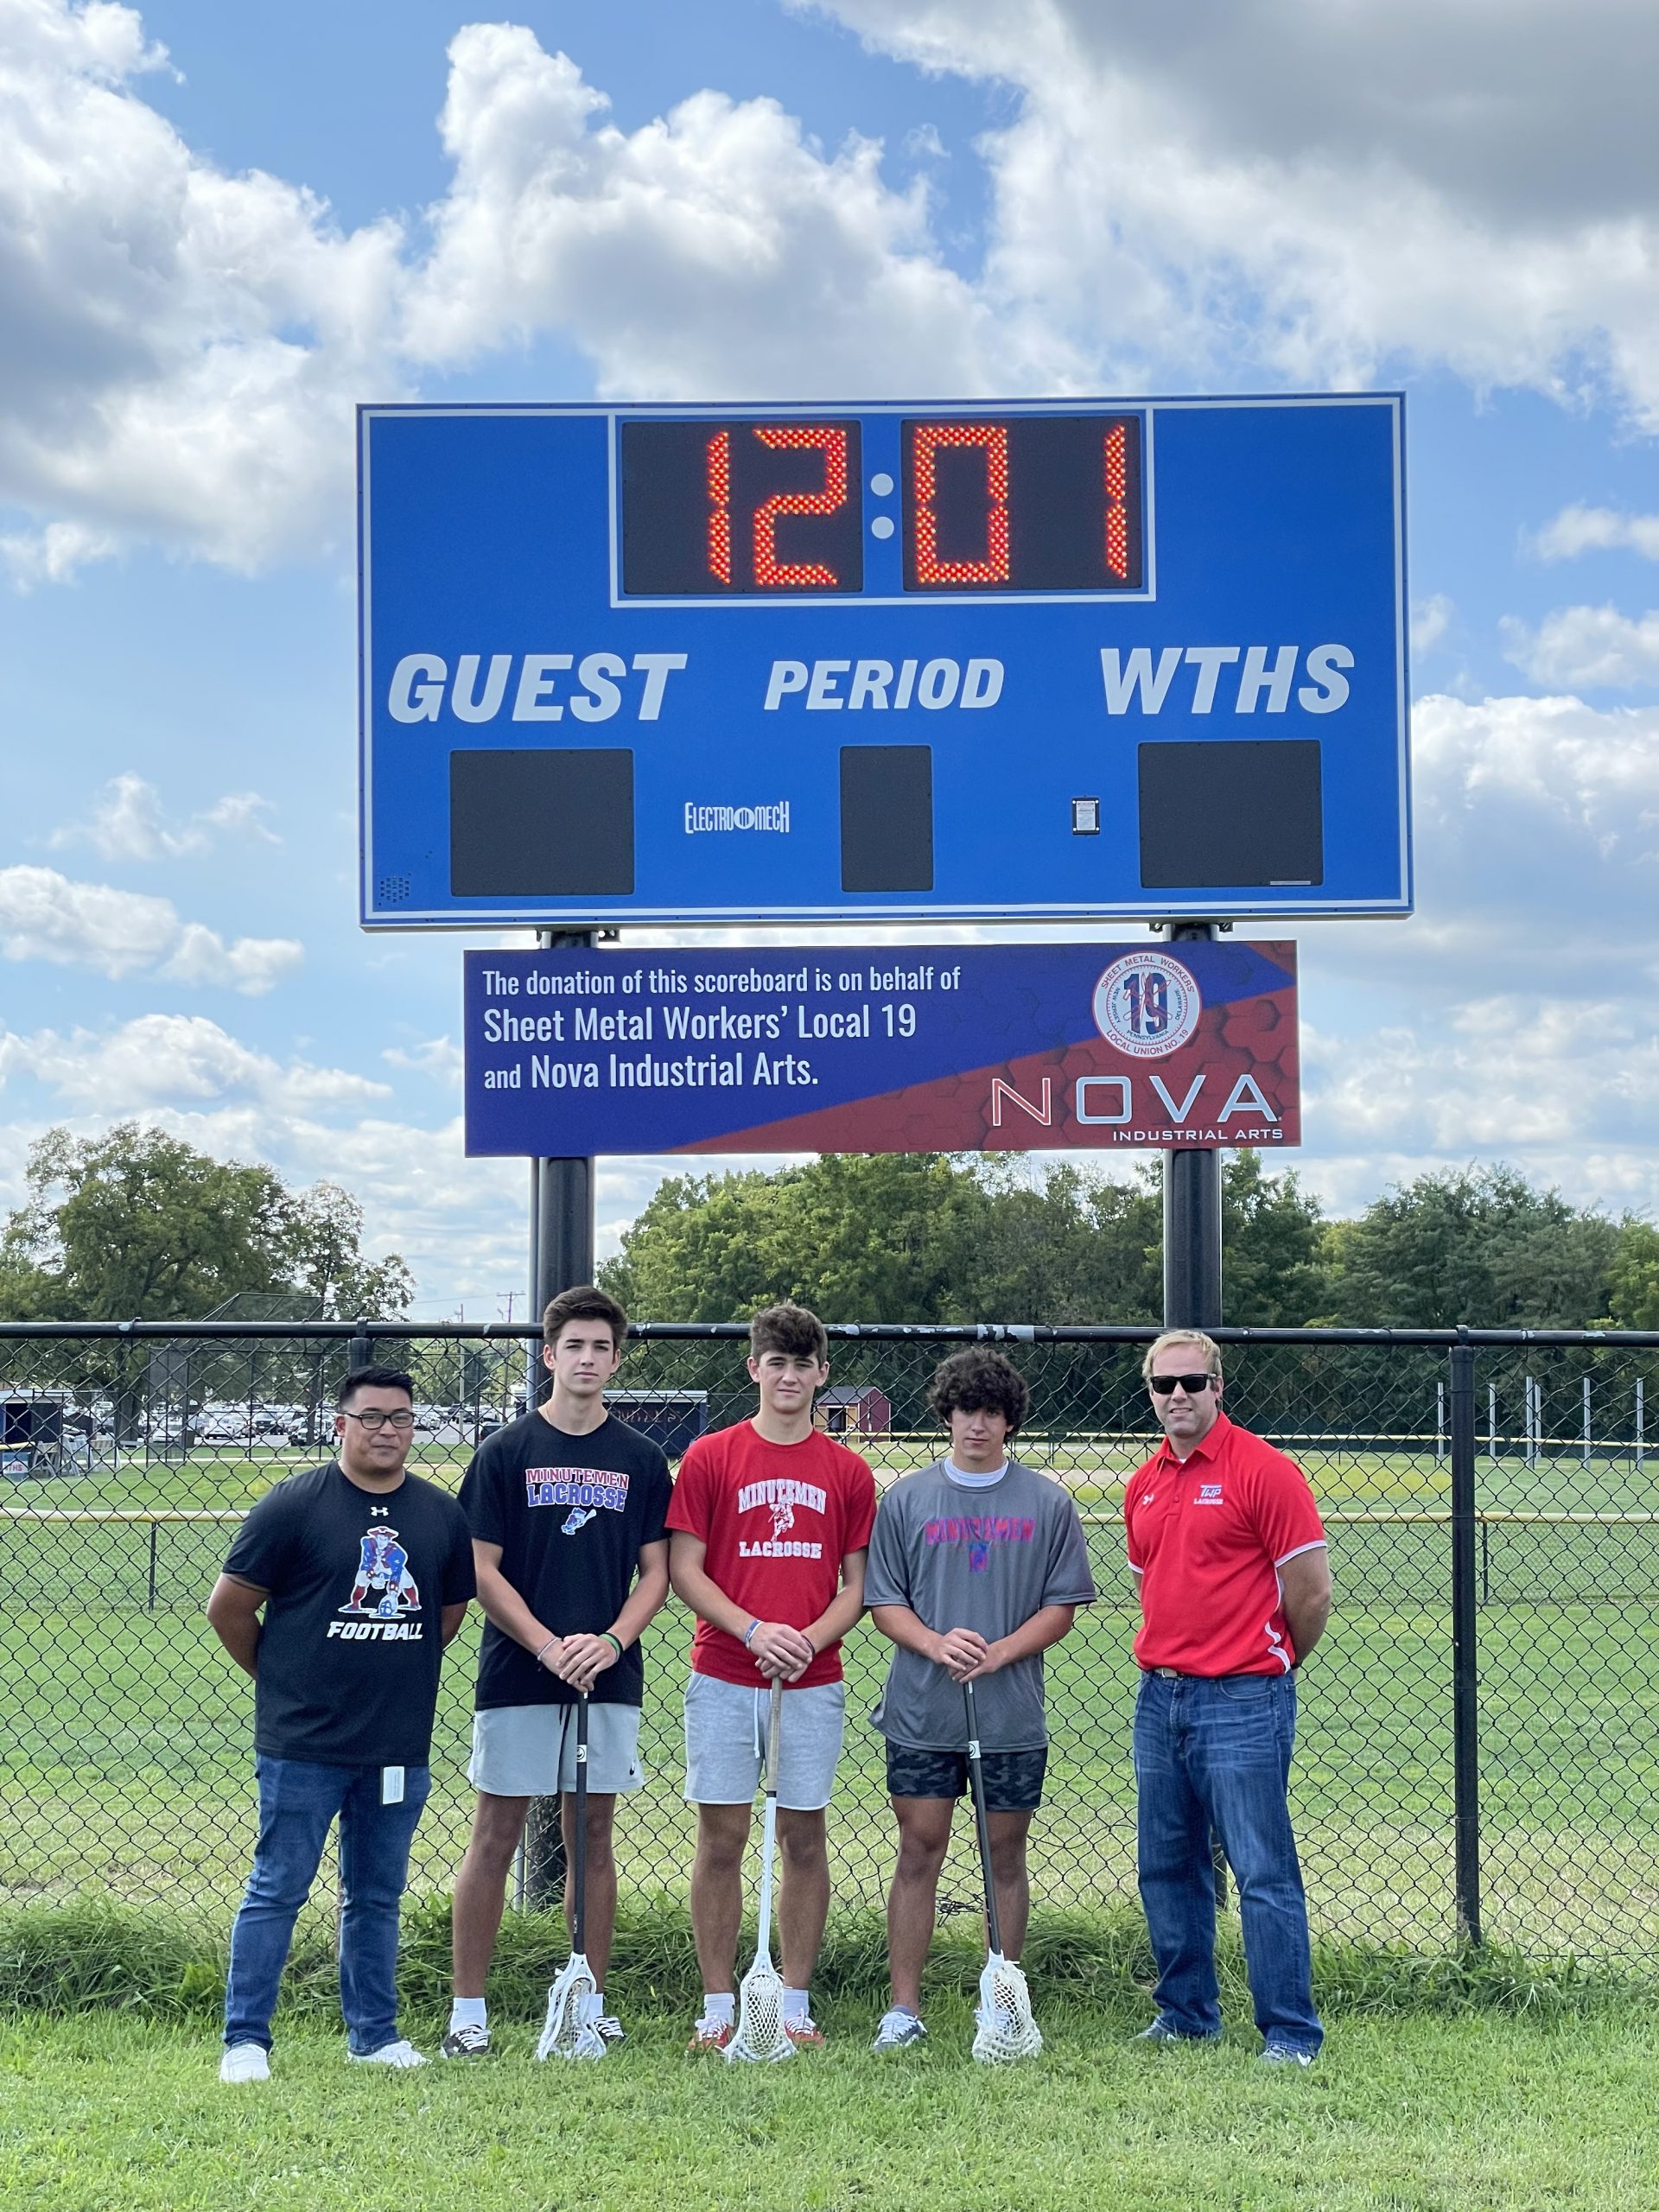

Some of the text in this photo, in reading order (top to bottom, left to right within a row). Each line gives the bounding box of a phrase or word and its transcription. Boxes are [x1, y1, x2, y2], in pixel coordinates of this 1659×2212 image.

[706, 424, 1128, 587] 12:01
[388, 644, 1355, 724] GUEST PERIOD WTHS
[483, 965, 962, 995] The donation of this scoreboard is on behalf of
[1101, 964, 1122, 989] SHEET
[1125, 955, 1155, 967] METAL
[1111, 1002, 1122, 1024] JERSEY
[1123, 972, 1168, 1035] 19
[483, 1003, 917, 1043] Sheet Metal Workers’ Local 19
[1126, 1029, 1170, 1041] PENNSYLVANIA
[1106, 1029, 1190, 1055] LOCAL UNION NO. 19
[484, 1052, 818, 1089] and Nova Industrial Arts.
[991, 1073, 1279, 1127] NOVA
[1113, 1128, 1283, 1142] INDUSTRIAL ARTS
[525, 1467, 630, 1490] MINUTEMEN
[526, 1483, 627, 1512] LACROSSE
[738, 1478, 827, 1516] MINUTEMEN
[739, 1541, 823, 1560] LACROSSE
[327, 1621, 423, 1641] FOOTBALL
